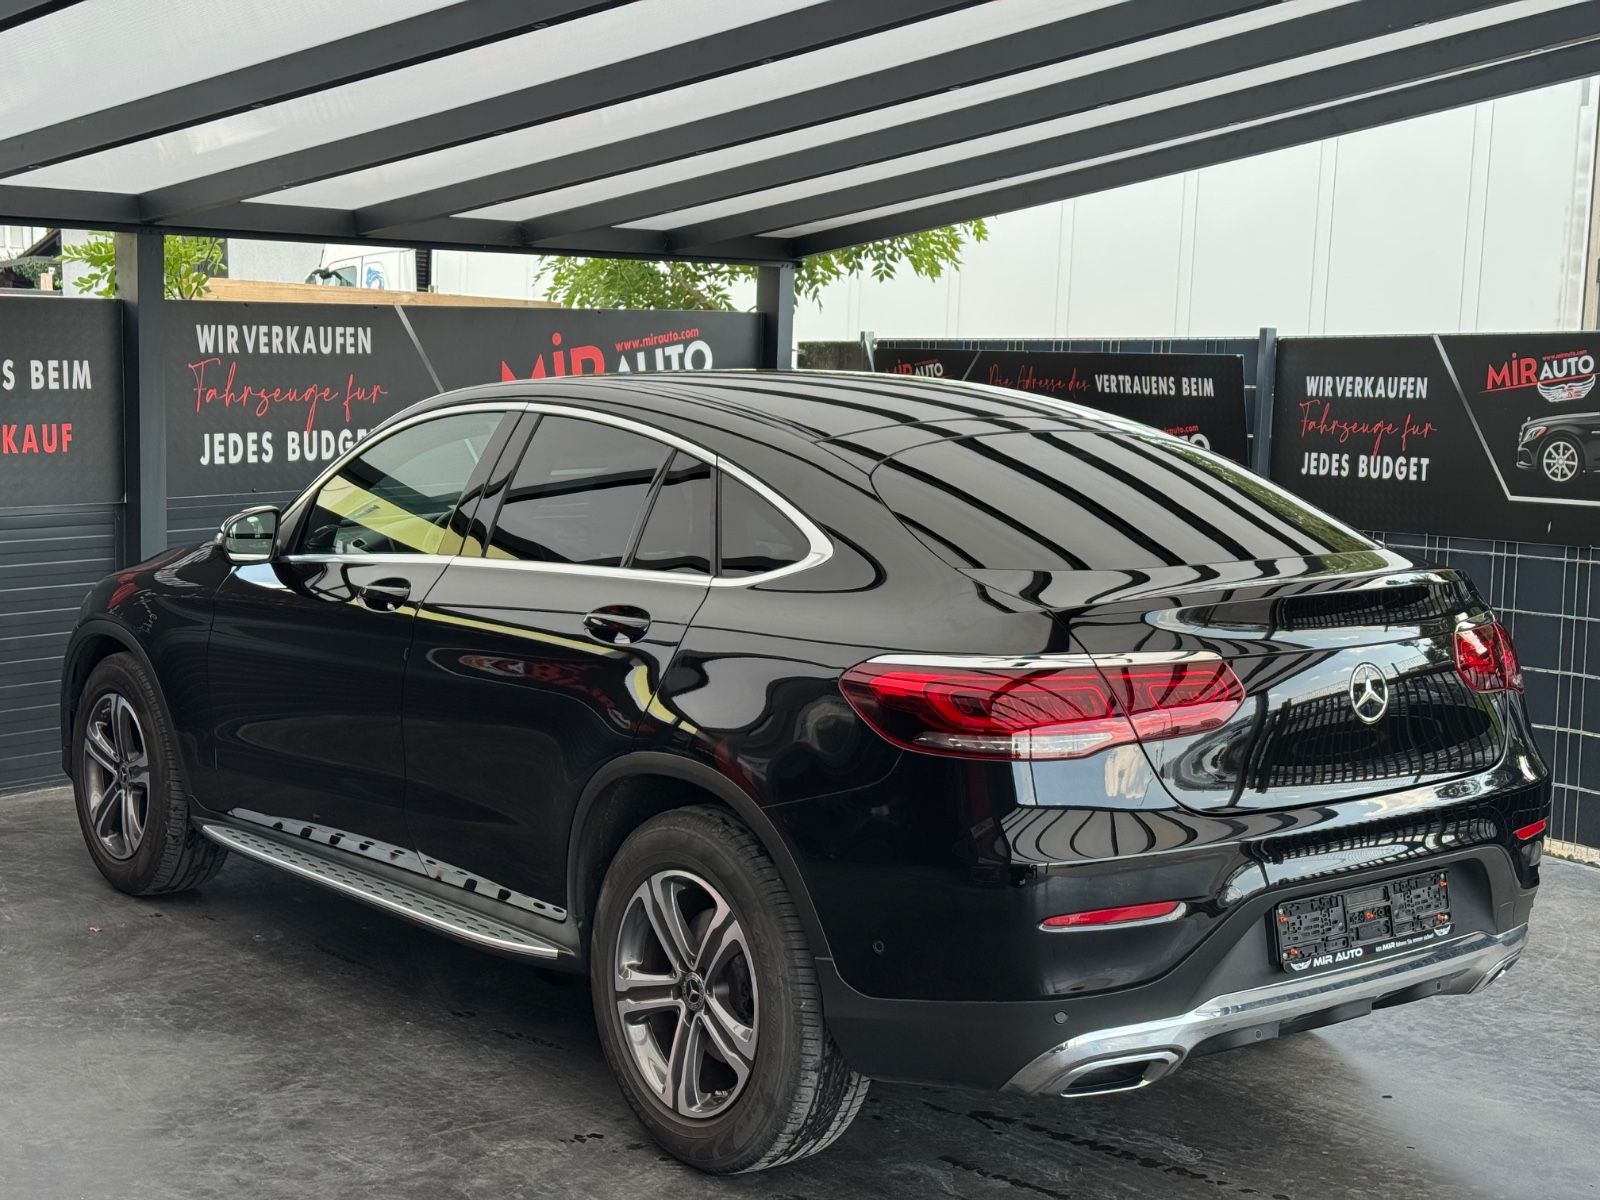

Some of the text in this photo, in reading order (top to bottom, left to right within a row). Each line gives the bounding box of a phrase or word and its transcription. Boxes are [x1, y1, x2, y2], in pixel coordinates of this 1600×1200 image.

[195, 324, 372, 354] WIR VERKAUFEN
[614, 327, 699, 352] www.mirauto.com
[30, 359, 92, 390] BEIM
[915, 363, 944, 378] AUTO
[1540, 355, 1595, 381] AUTO
[188, 358, 389, 433] Fahrzeuge fur
[1095, 374, 1176, 396] VERTRAUENS
[1182, 377, 1214, 397] BEIM
[1306, 375, 1428, 399] WIR VERKAUFEN
[2, 423, 73, 454] KAUF
[1299, 399, 1438, 458] Fahrzeuge fur
[200, 429, 374, 465] JEDES BUDG
[1301, 452, 1430, 481] JEDES BUDGET
[1313, 954, 1333, 968] MIR
[1335, 947, 1363, 962] AUTO
